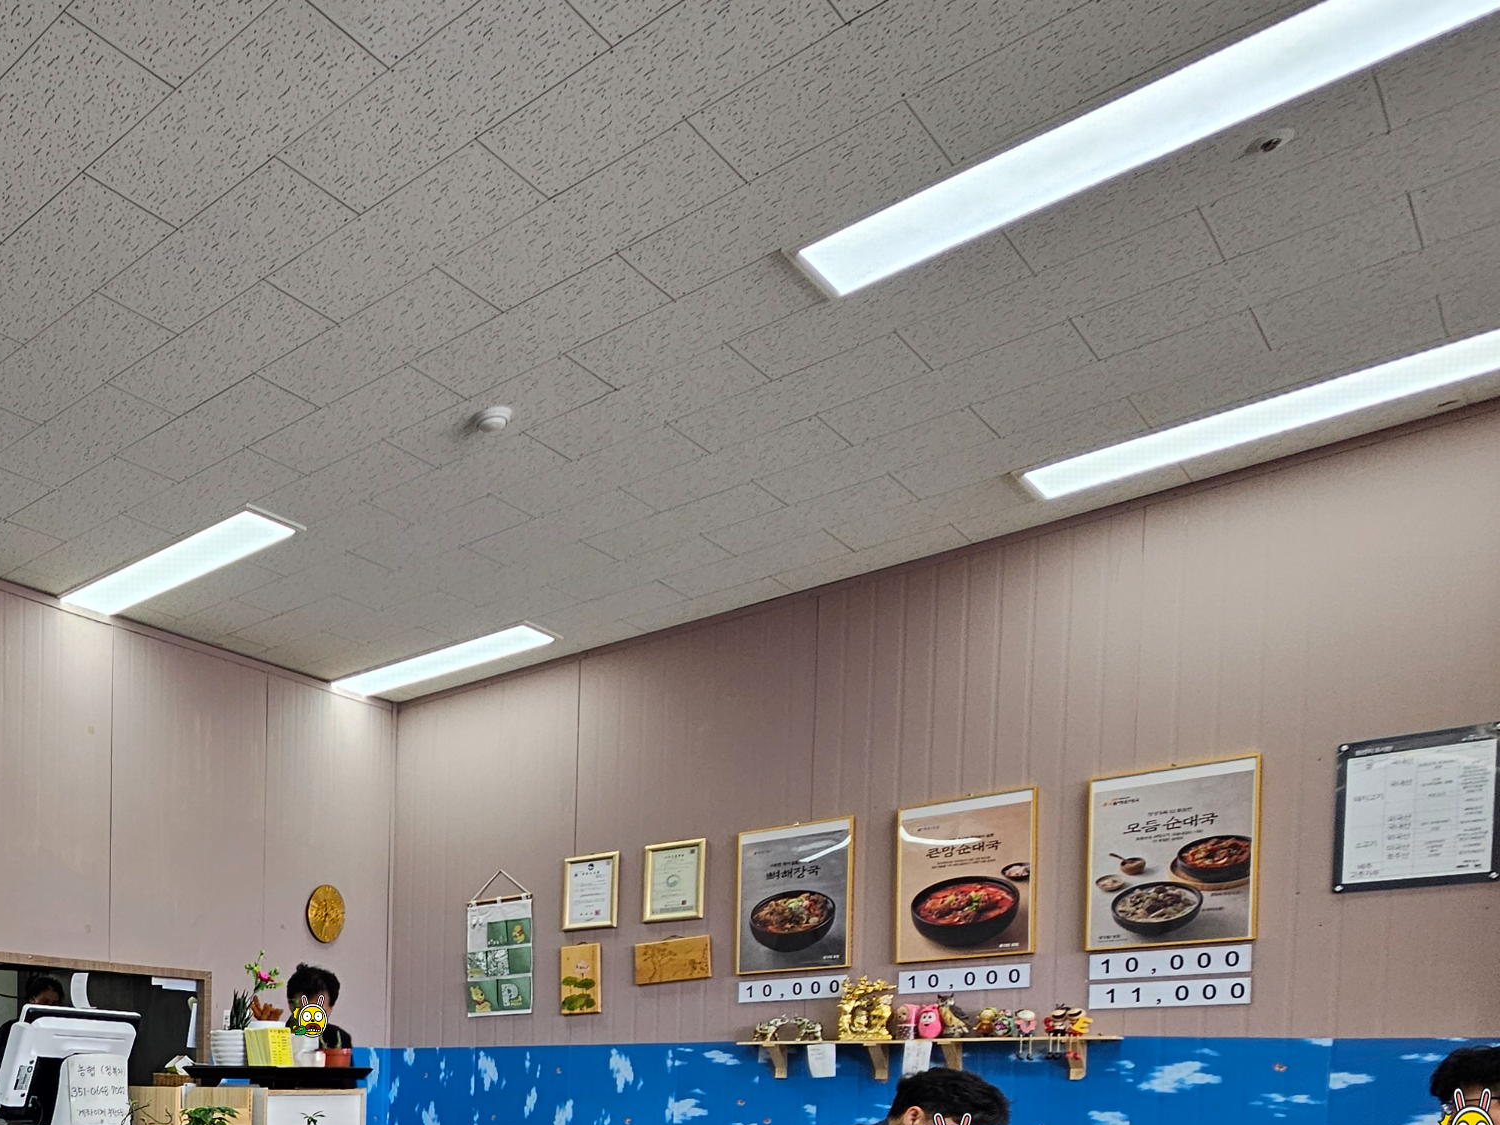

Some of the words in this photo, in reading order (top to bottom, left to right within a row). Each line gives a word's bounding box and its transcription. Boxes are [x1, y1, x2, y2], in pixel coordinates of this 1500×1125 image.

[1162, 811, 1219, 831] 순대국
[766, 865, 821, 880] 뼈해장국
[1101, 950, 1240, 975] 10,000
[746, 980, 840, 998] 10,000
[908, 968, 1021, 990] 10,000
[1106, 982, 1245, 1005] 11,000
